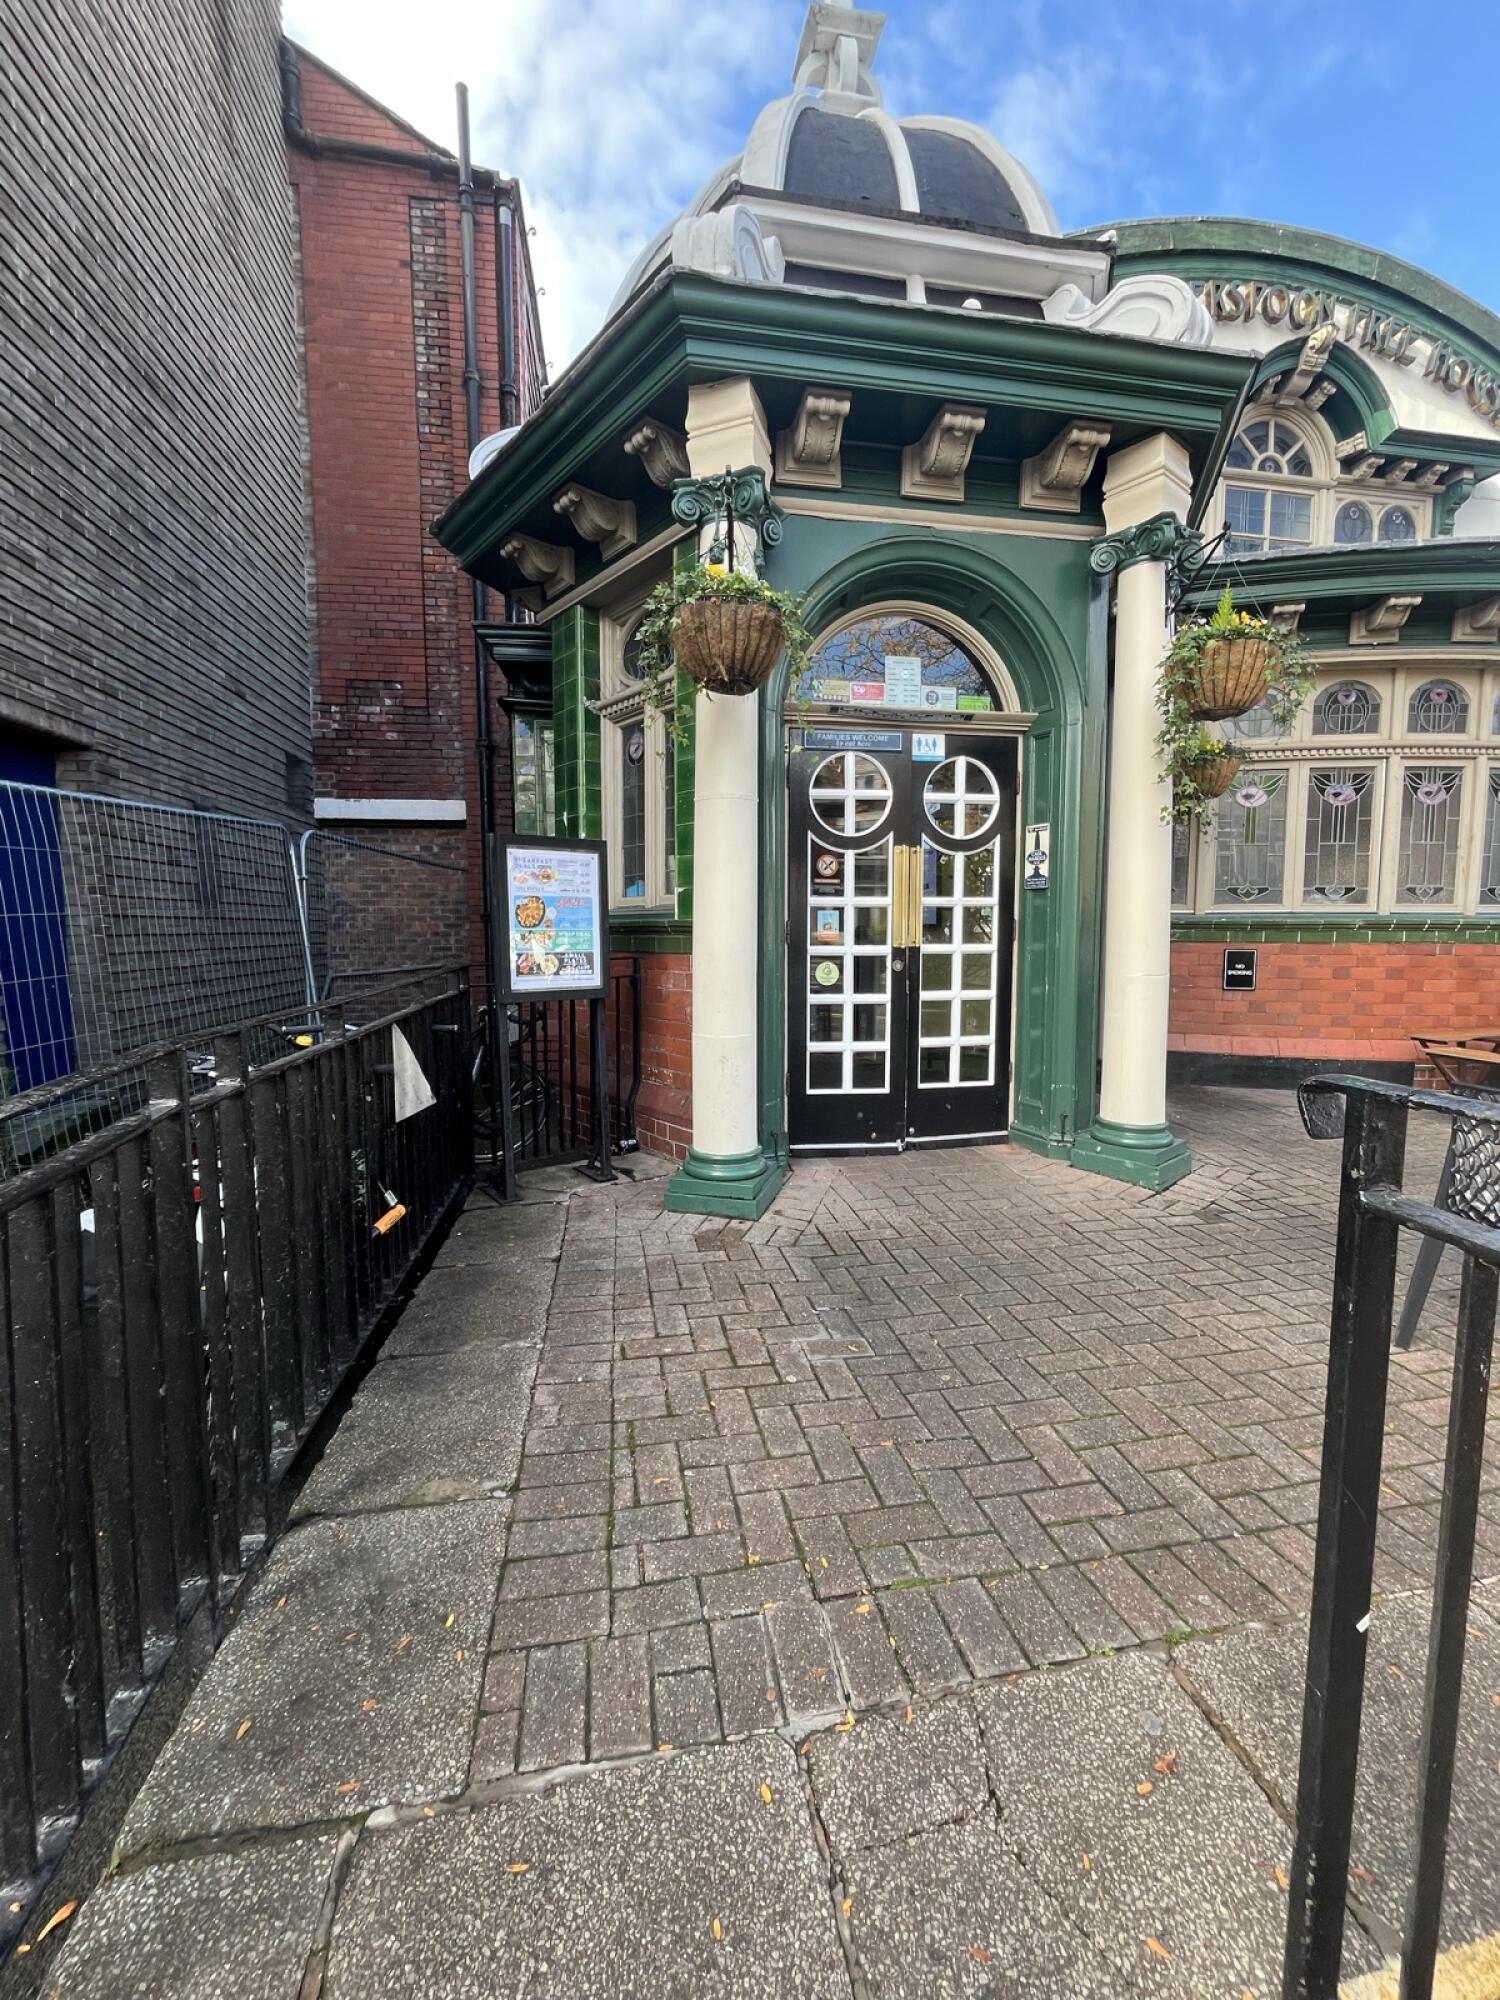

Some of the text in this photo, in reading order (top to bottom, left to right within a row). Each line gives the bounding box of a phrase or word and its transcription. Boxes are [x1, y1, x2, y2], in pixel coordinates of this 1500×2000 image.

[1344, 302, 1416, 367] FREE
[817, 733, 889, 742] FAMILIES WELCOME
